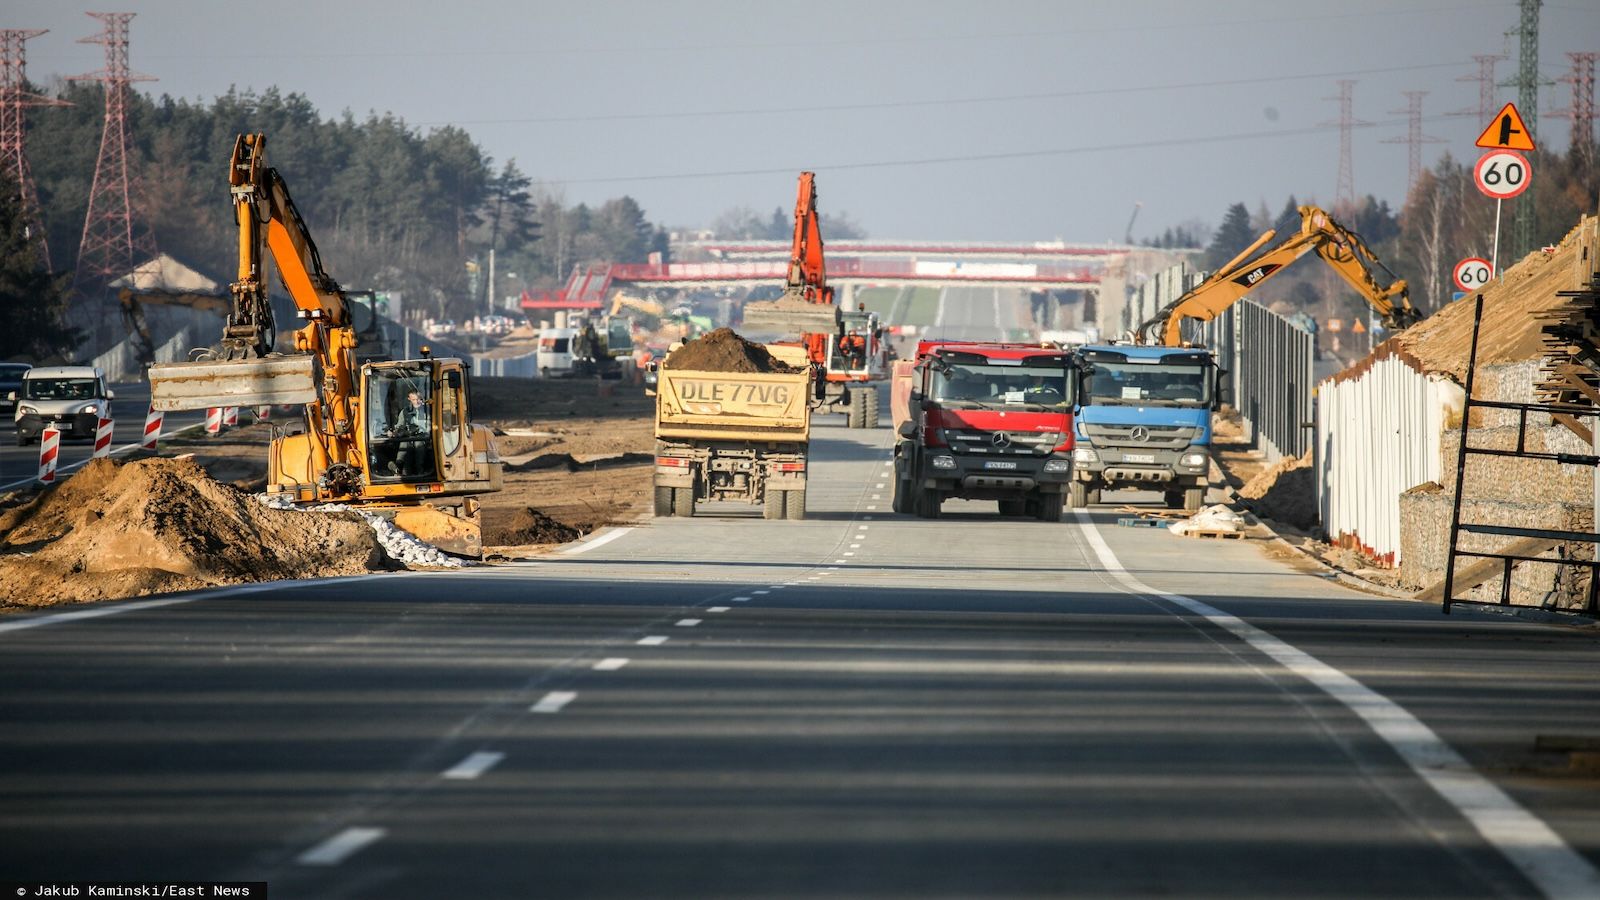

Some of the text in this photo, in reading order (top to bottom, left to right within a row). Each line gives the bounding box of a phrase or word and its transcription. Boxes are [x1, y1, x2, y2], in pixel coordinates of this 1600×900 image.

[1484, 162, 1522, 185] 60
[1247, 268, 1264, 283] CAT
[1461, 267, 1489, 283] 60
